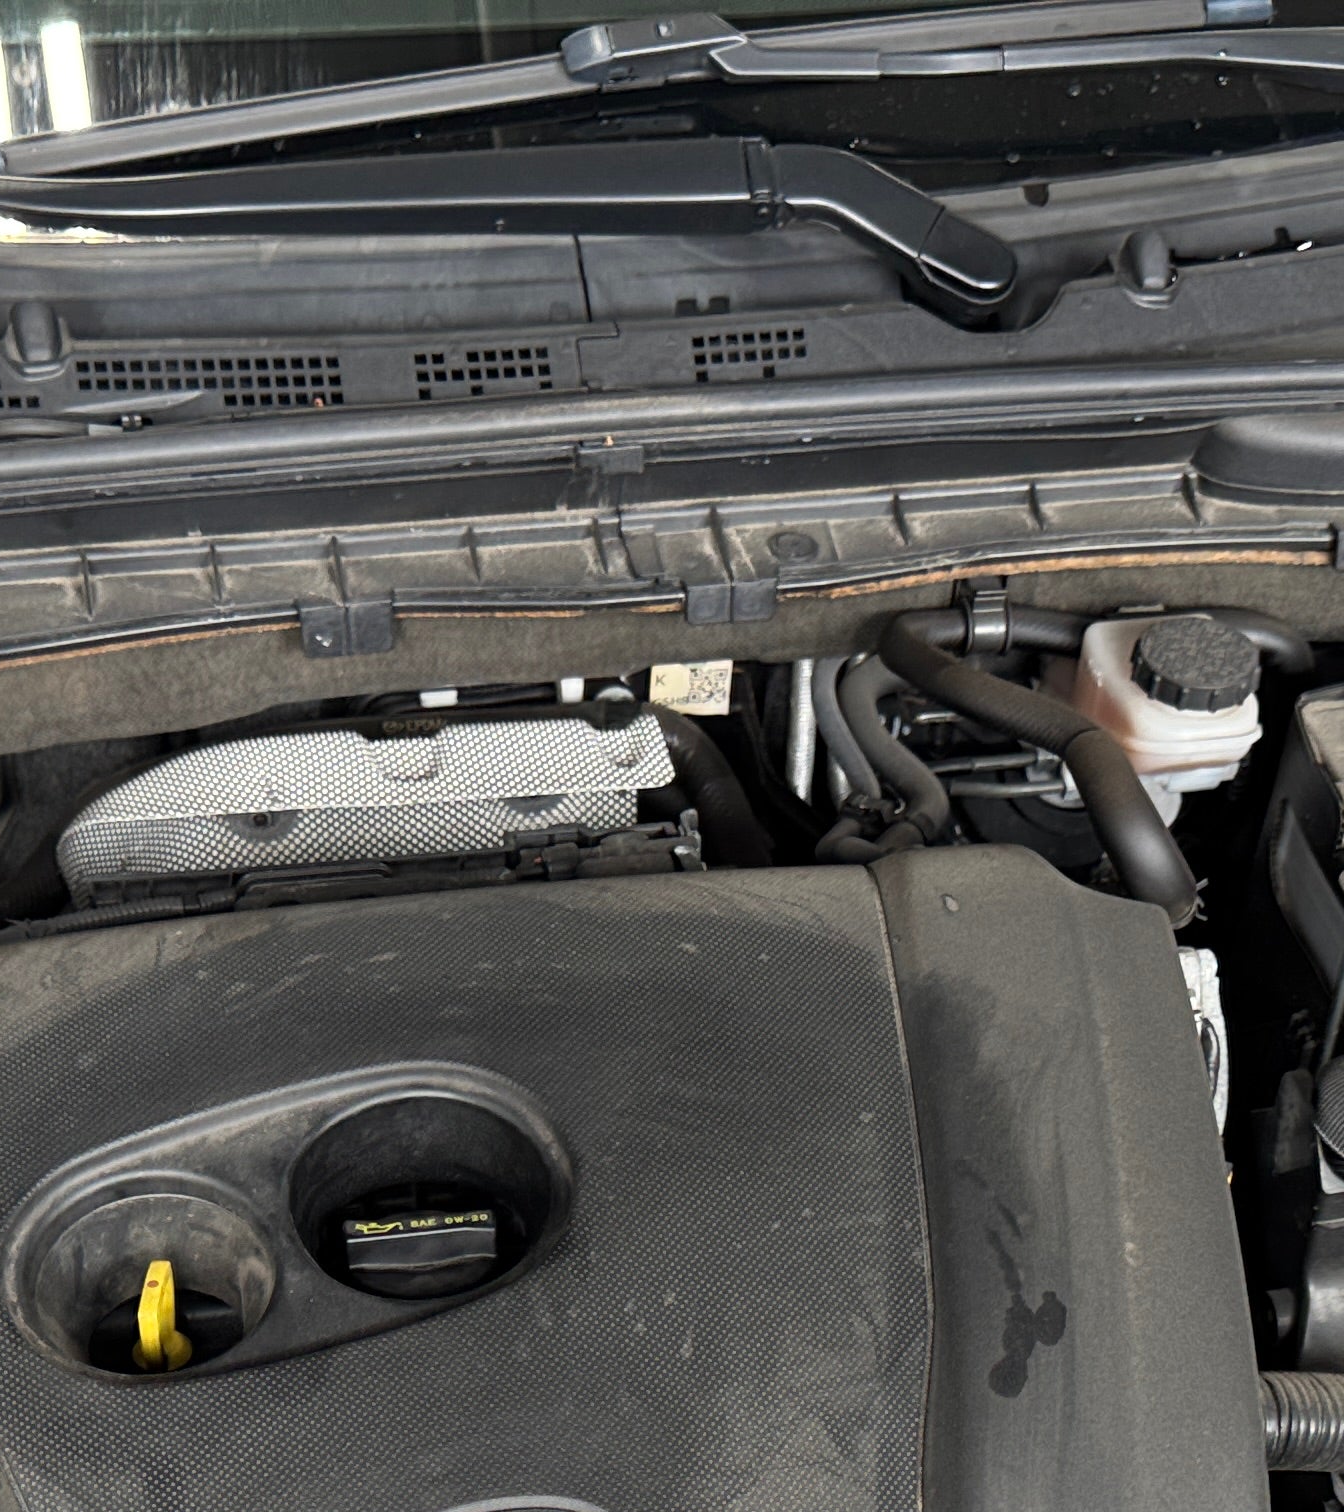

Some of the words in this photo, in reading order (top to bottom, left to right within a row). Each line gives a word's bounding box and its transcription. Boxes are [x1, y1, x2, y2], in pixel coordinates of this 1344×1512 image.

[655, 673, 666, 687] K
[410, 1219, 437, 1228] SAE
[445, 1213, 488, 1224] 0W-20
